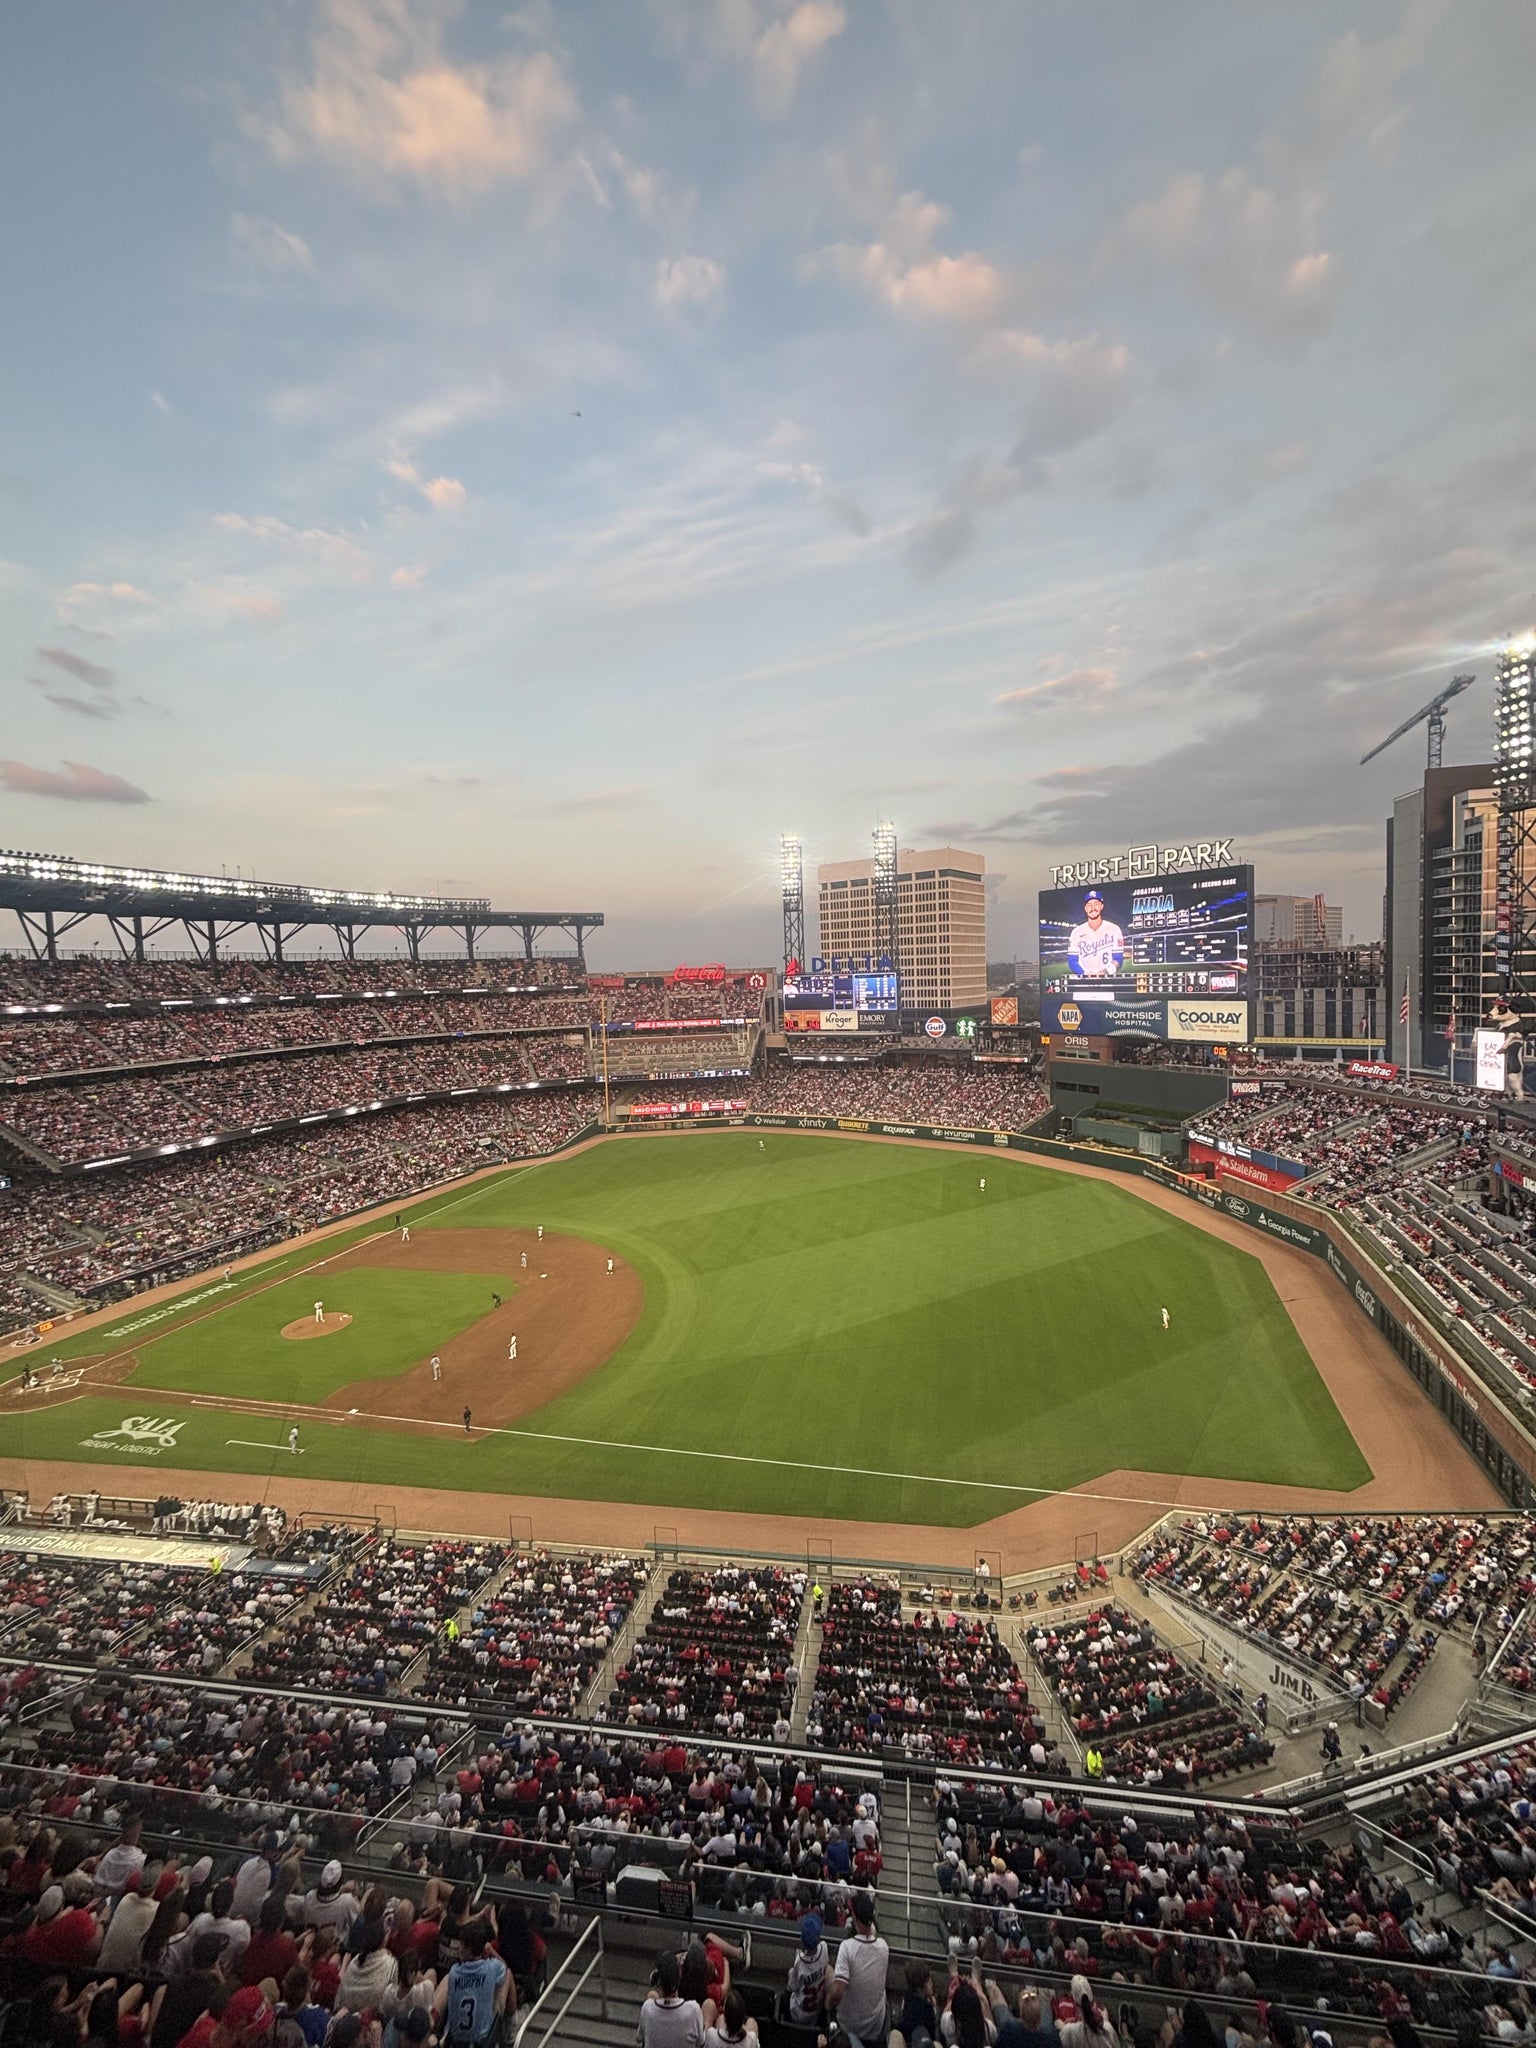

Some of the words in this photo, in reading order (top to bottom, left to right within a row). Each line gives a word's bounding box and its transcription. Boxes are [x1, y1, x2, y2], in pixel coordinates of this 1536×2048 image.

[1050, 856, 1124, 884] TRUIST
[1163, 838, 1234, 870] PARK
[1132, 894, 1174, 914] INDIA
[1078, 934, 1114, 957] Royals
[811, 954, 893, 973] DELTA
[1102, 952, 1109, 964] 6
[1189, 975, 1194, 985] 1
[1199, 975, 1206, 985] 0
[859, 1014, 886, 1022] EMORY
[993, 999, 1016, 1023] HOME
[1061, 1011, 1079, 1022] NAPA
[1105, 1011, 1162, 1020] NORTHSIDE
[1178, 1011, 1243, 1025] COOLRAY
[826, 1012, 852, 1028] Kroger
[1064, 1036, 1088, 1045] ORIS
[1484, 1043, 1498, 1051] EAT
[1351, 1063, 1392, 1077] RaceTrac
[798, 1117, 827, 1128] xfinity
[838, 1120, 869, 1129] QUIKRETE
[883, 1125, 916, 1135] EQUIFAX
[944, 1130, 975, 1138] HYUNDAI
[1268, 1219, 1290, 1236] Georgia
[1291, 1228, 1311, 1245] Power
[92, 1416, 187, 1447] SAIA
[78, 1439, 117, 1449] FREIGHT
[118, 1444, 165, 1455] LOGISTICS
[52, 1540, 95, 1551] PARK
[1269, 1664, 1299, 1693] JIM
[454, 1972, 487, 1991] MURPHY
[459, 1997, 476, 2031] 3
